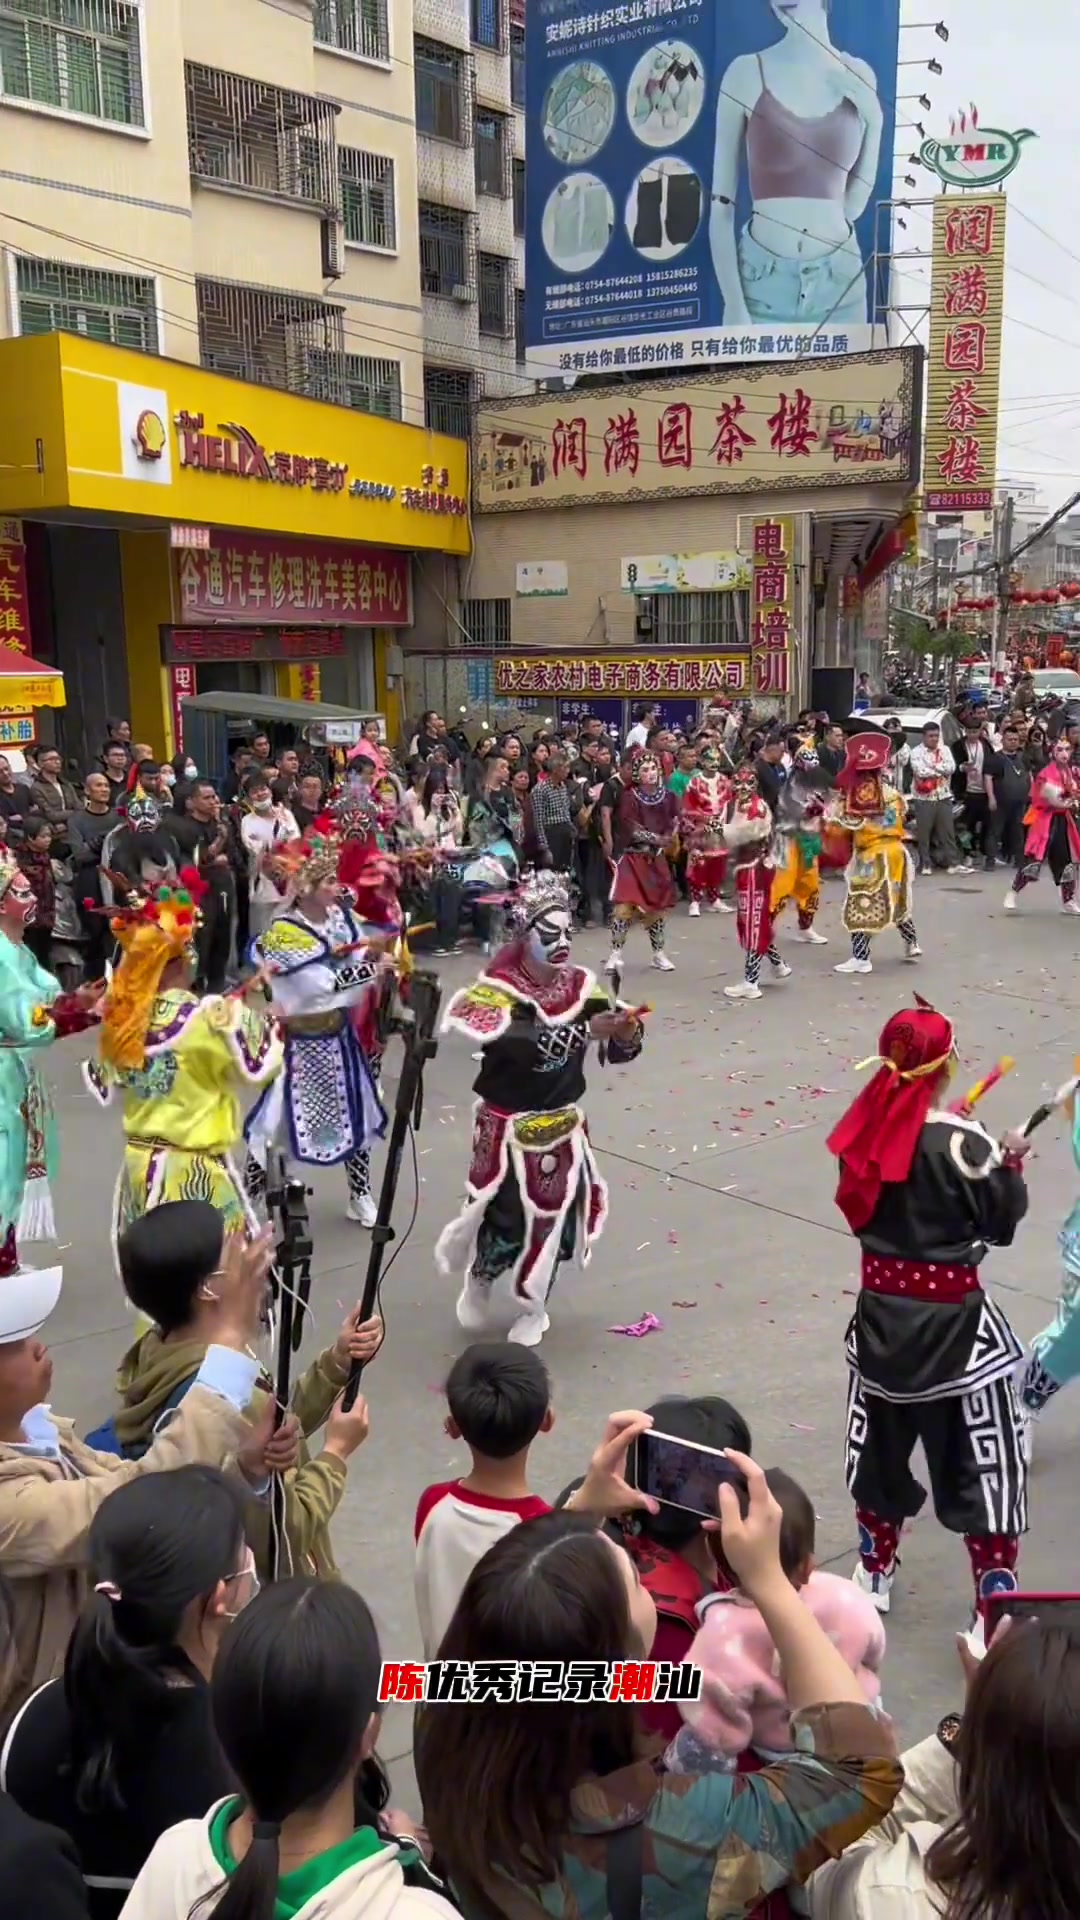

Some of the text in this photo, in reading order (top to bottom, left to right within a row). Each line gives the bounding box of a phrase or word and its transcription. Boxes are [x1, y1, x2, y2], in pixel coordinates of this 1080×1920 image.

[940, 143, 1007, 162] YMR
[559, 333, 849, 370] 没有给你最低的价格 只有给你最优的品质
[937, 204, 994, 485] 润满园茶楼
[182, 424, 272, 480] HELIX
[271, 451, 348, 492] 壳牌喜力
[552, 388, 820, 480] 润满园茶楼
[941, 492, 990, 505] 82115333
[180, 547, 402, 612] 谷通汽车修理洗车美容中心
[751, 518, 791, 694] 电商培训
[498, 660, 745, 692] 优之家农村电子商务有限公司
